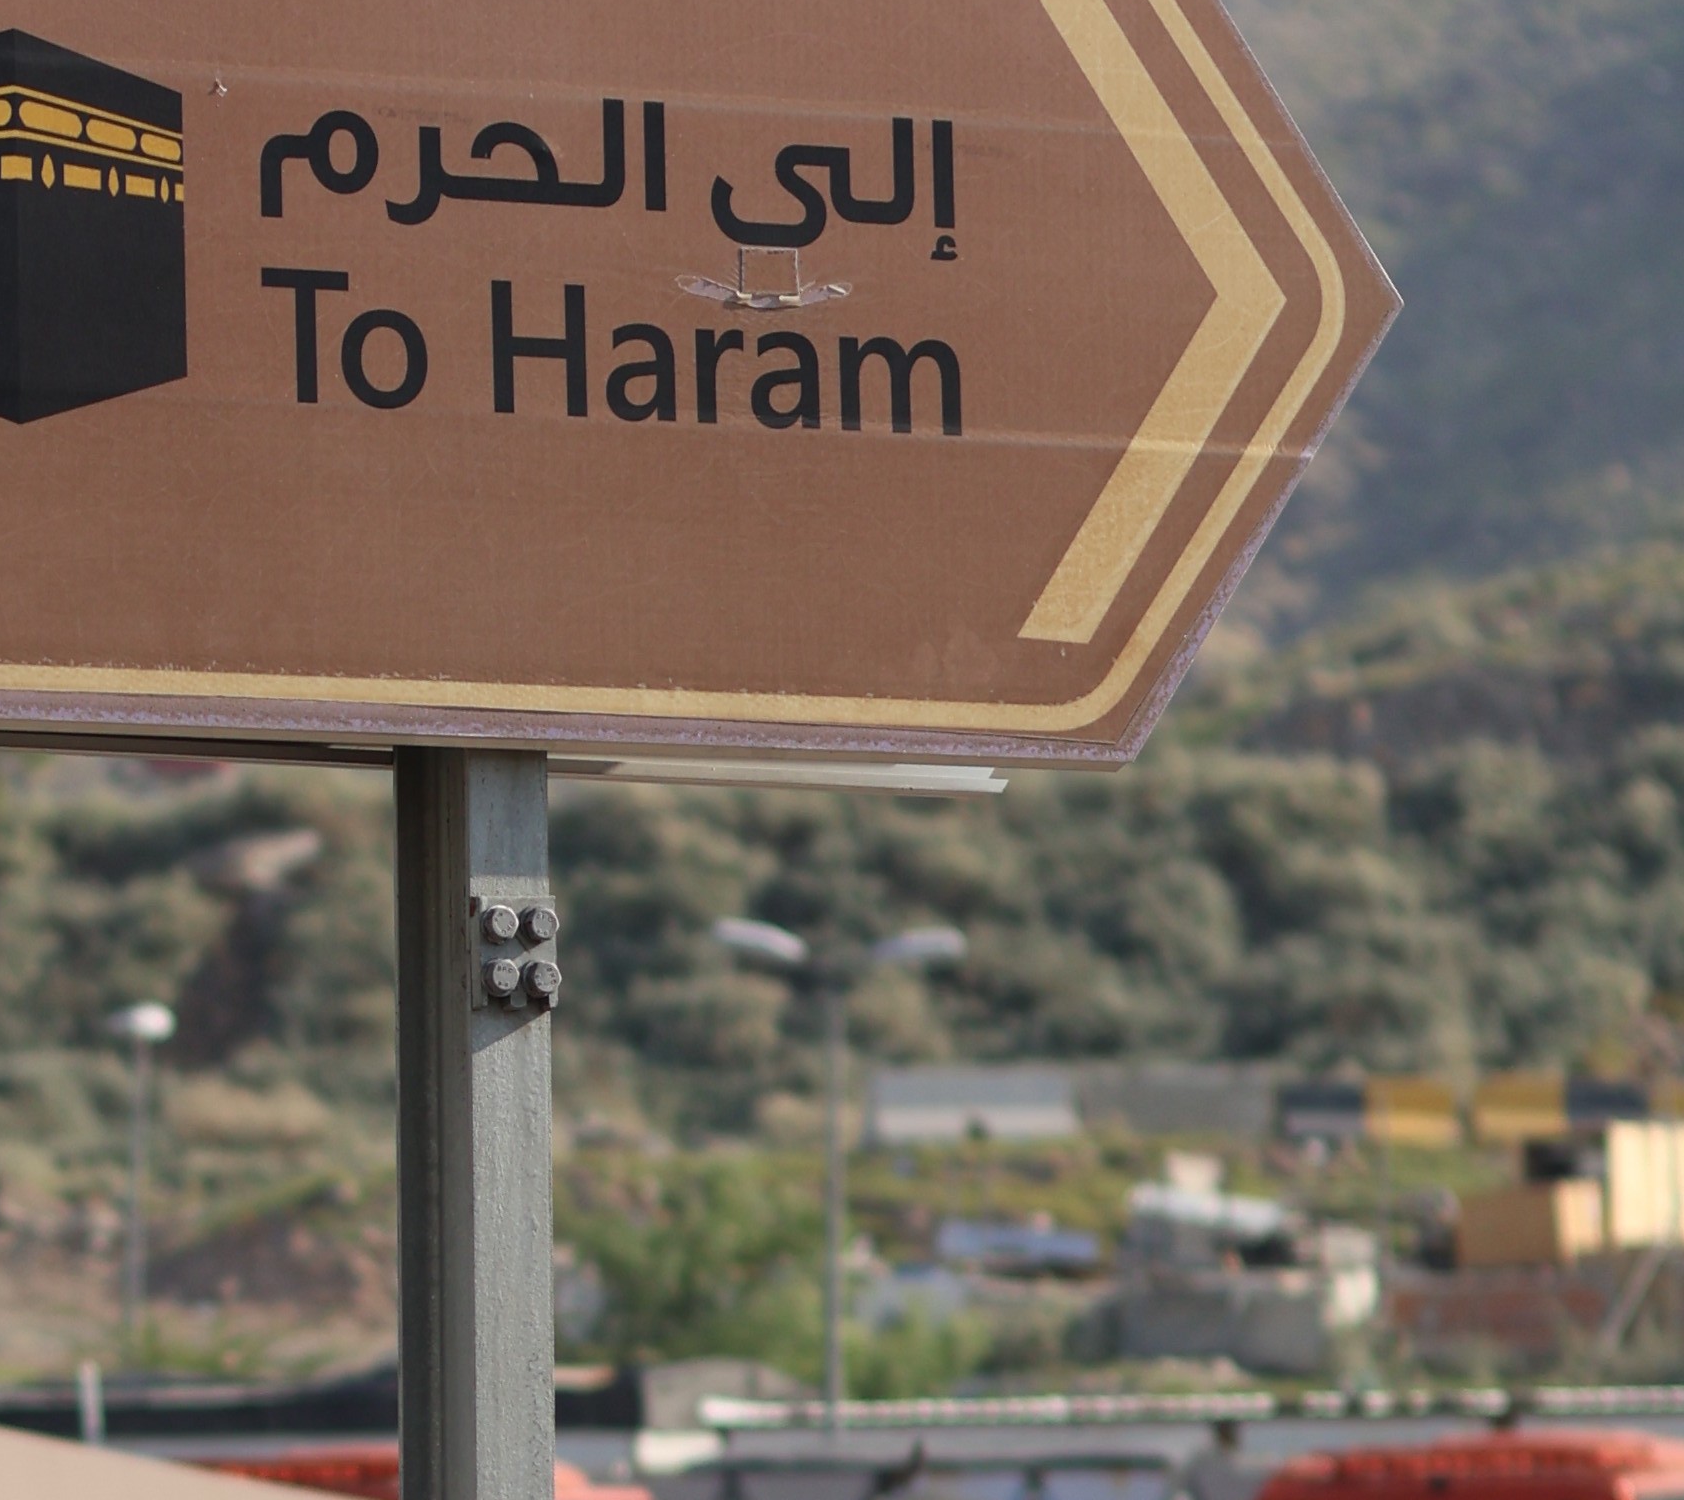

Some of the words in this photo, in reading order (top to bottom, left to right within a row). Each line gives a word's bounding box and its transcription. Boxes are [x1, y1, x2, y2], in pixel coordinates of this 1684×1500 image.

[260, 98, 668, 227] الحرم
[710, 117, 959, 262] إلى
[260, 267, 428, 410] To
[491, 279, 962, 437] Haram
